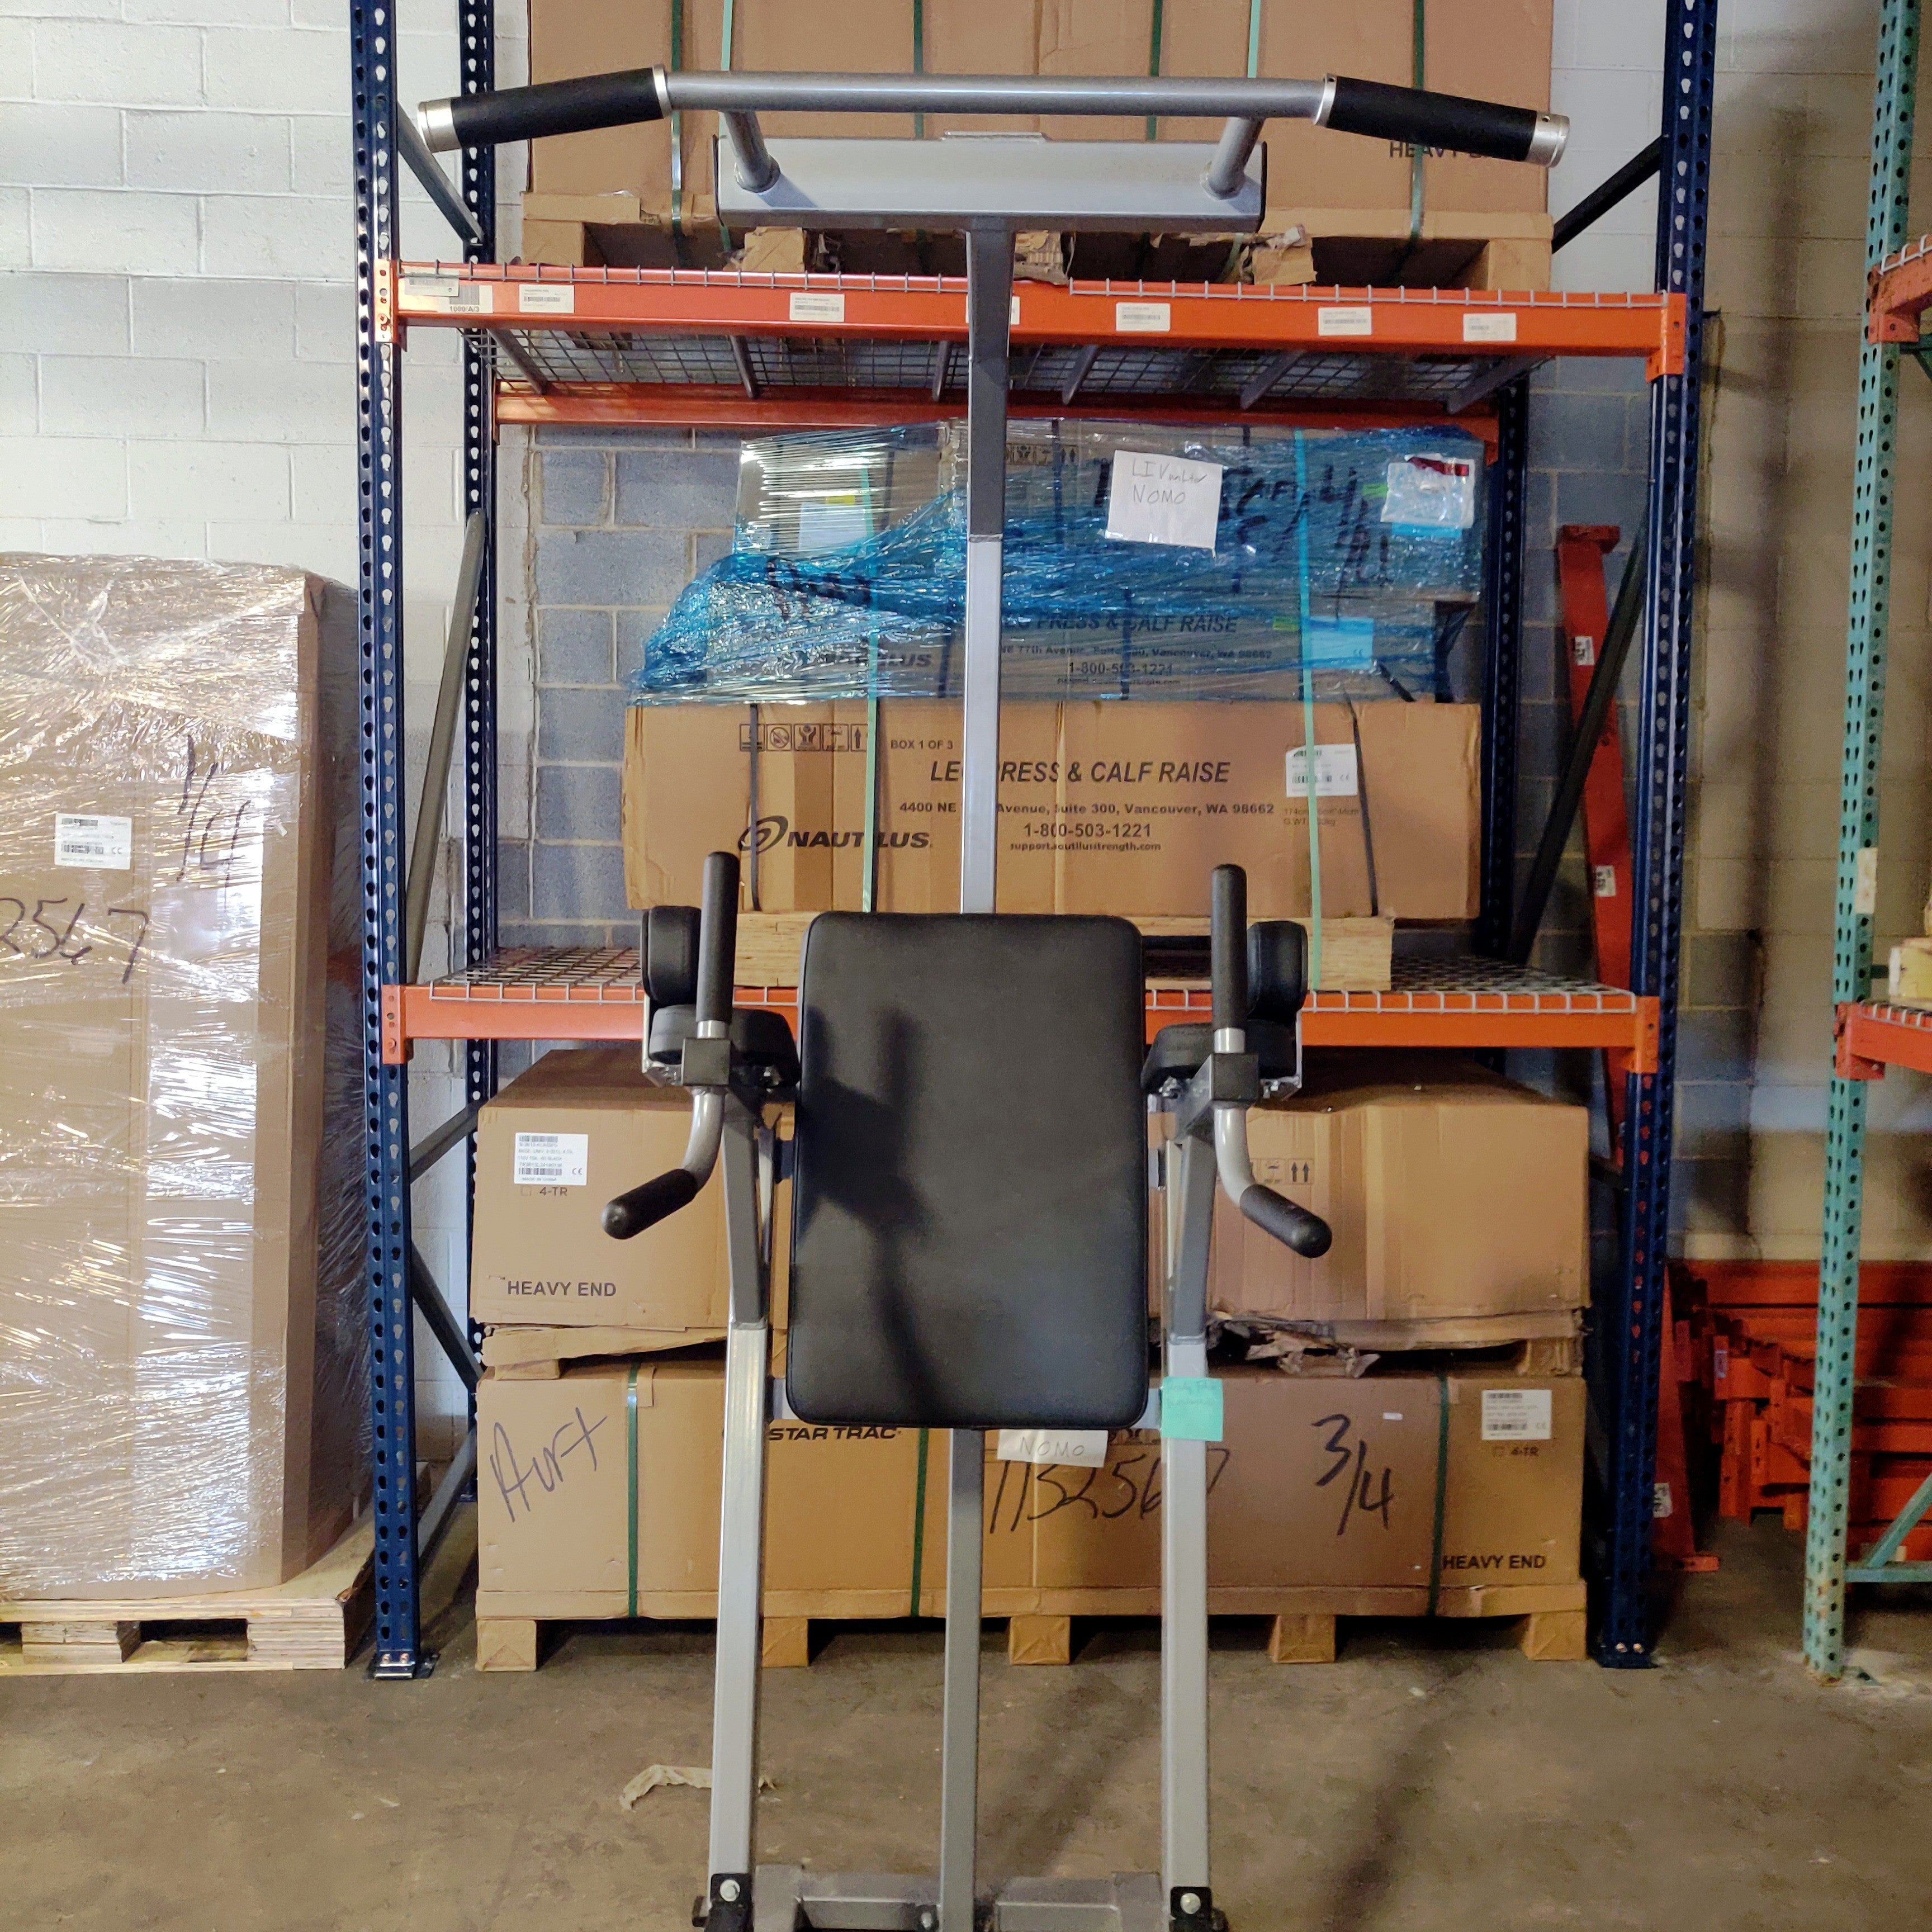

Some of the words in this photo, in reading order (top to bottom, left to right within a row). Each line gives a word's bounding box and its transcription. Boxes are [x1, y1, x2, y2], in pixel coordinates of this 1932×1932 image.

[1133, 484, 1186, 504] NOMO
[891, 740, 915, 749] BOX
[918, 740, 924, 749] 1
[928, 740, 942, 749] OF
[947, 740, 953, 749] 3
[930, 761, 963, 782] LE
[998, 761, 1060, 782] RESS
[1068, 761, 1082, 782] &
[1091, 761, 1154, 783] CALF
[1159, 761, 1231, 783] RAISE
[899, 802, 932, 812] 4400
[937, 802, 956, 813] NE
[1092, 804, 1120, 816] 300,
[1125, 803, 1202, 816] Vancouver,
[1206, 803, 1228, 814] WA
[1233, 803, 1274, 814] 98662
[787, 831, 930, 848] NAUTLUS
[539, 1186, 568, 1196] 4-TR
[508, 1280, 571, 1296] HEAVY
[578, 1282, 617, 1297] END
[768, 1427, 829, 1441] STAR
[833, 1427, 897, 1439] TRAC
[1020, 1436, 1085, 1458] NOMO
[1311, 1414, 1395, 1536] 3/4
[1442, 1555, 1504, 1570] HEAVY
[1508, 1555, 1546, 1570] END
